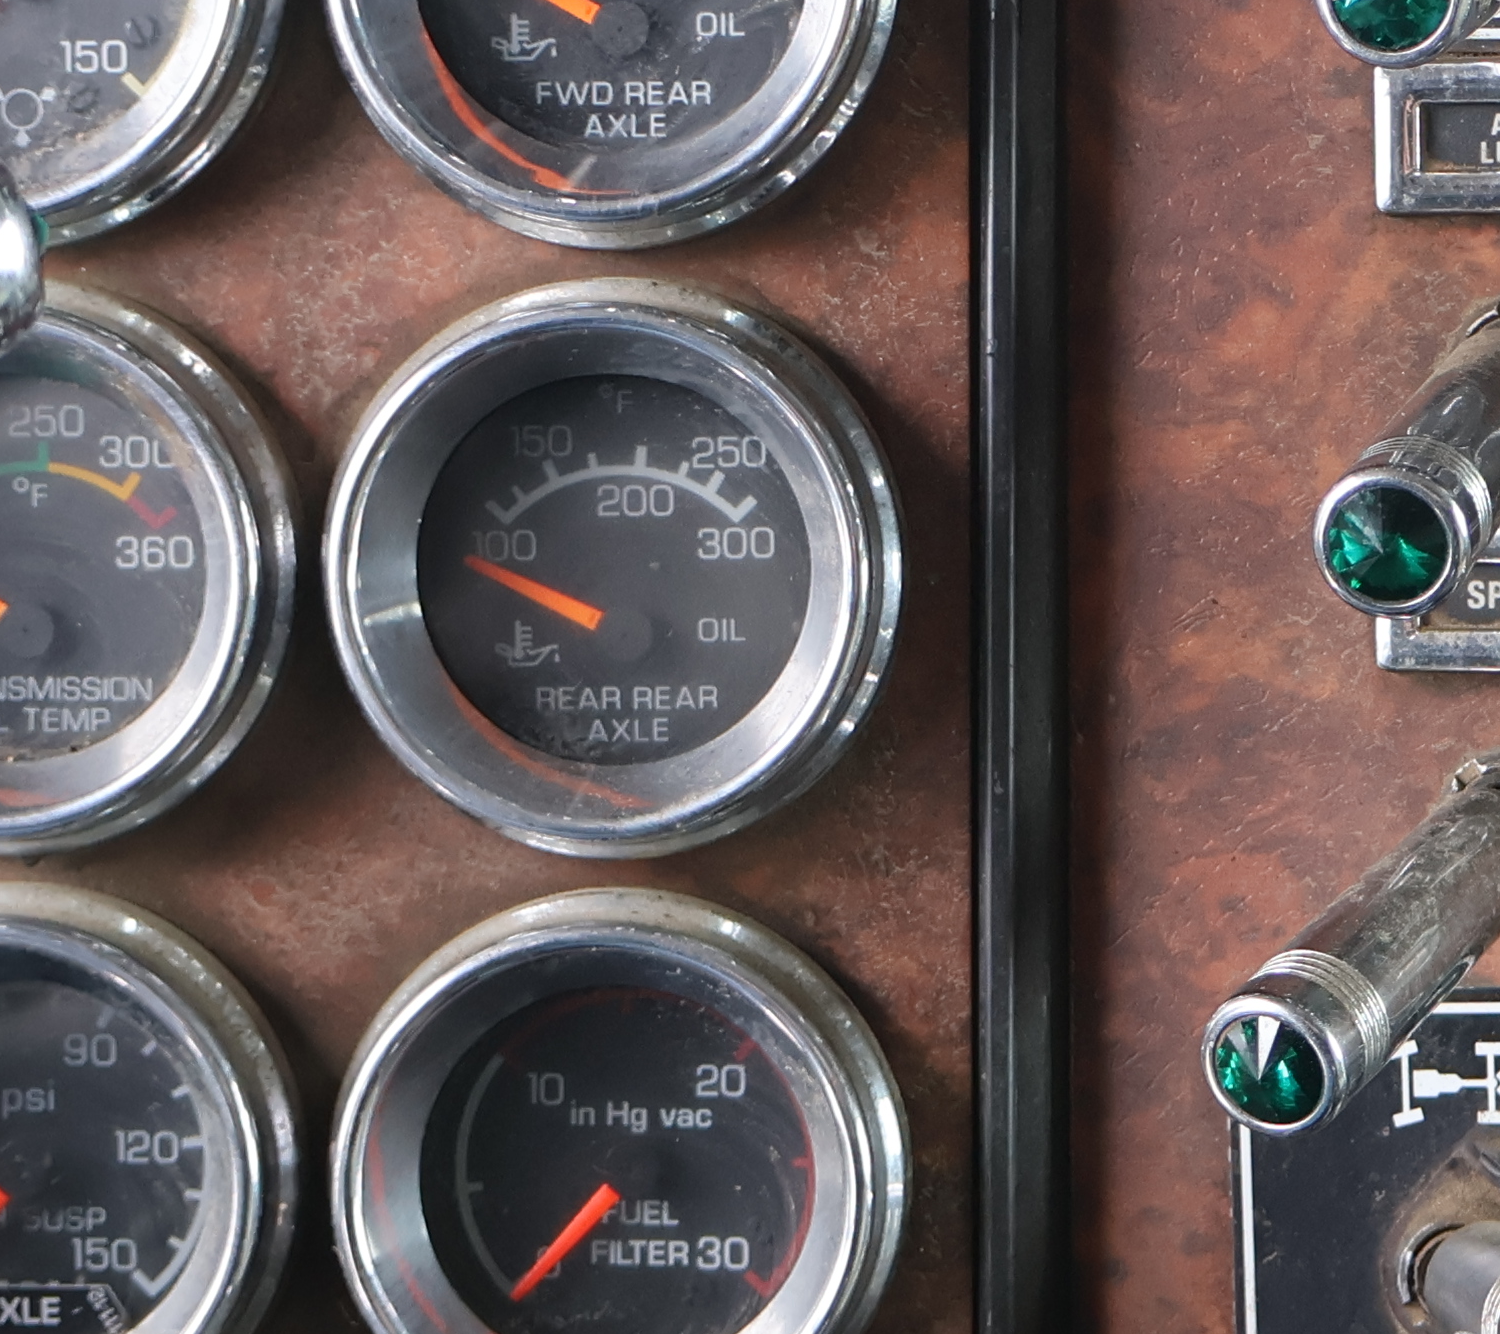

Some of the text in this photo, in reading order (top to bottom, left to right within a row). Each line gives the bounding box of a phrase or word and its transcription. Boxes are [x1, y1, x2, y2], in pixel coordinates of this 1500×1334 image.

[695, 11, 746, 38] OIL
[59, 40, 129, 75] 150
[535, 80, 712, 107] FWD REAR
[583, 113, 668, 139] AXLE
[7, 405, 86, 439] 250
[509, 424, 574, 458] 150
[689, 435, 767, 469] 250
[595, 483, 675, 518] 200
[114, 535, 195, 570] 360
[696, 526, 776, 560] 300
[697, 618, 746, 643] OIL
[535, 686, 719, 712] REAR REAR
[24, 706, 112, 733] TEMP
[588, 717, 670, 742] AXLE
[62, 1033, 118, 1068] 90
[528, 1072, 566, 1106] 10
[695, 1064, 747, 1098] 20
[1, 1079, 56, 1120] psi
[570, 1100, 712, 1134] in Hg vac
[114, 1129, 181, 1165] 120
[602, 1200, 680, 1227] FUEL
[71, 1236, 139, 1272] 150
[591, 1238, 690, 1267] FILTER
[695, 1235, 750, 1271] 30
